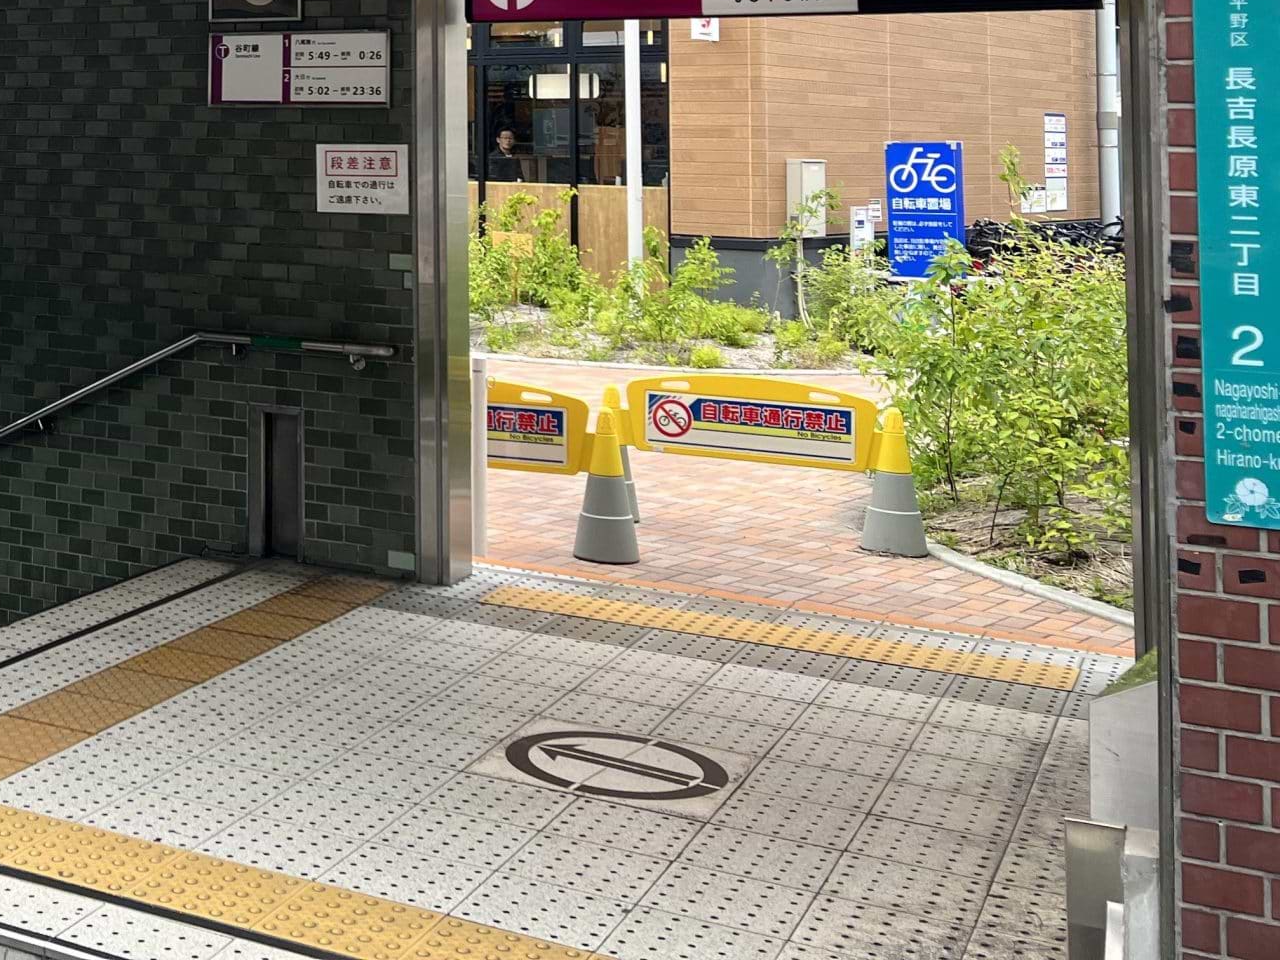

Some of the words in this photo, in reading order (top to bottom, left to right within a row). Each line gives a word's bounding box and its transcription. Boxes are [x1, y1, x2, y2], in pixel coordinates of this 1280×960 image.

[308, 50, 331, 60] 5:49
[358, 50, 382, 60] 0:26
[307, 86, 330, 96] 5:02
[352, 86, 382, 96] 23:36
[330, 156, 392, 171] 段差注意
[328, 180, 395, 190] 自転車での通行は
[1225, 66, 1261, 297] 長吉長原東二丁目
[891, 197, 952, 211] 自転車置場
[1231, 324, 1265, 368] 2
[1214, 378, 1280, 402] Nagayoshi
[700, 401, 848, 433] 自転車通行禁止
[797, 431, 809, 439] No
[810, 431, 842, 441] Bicycles
